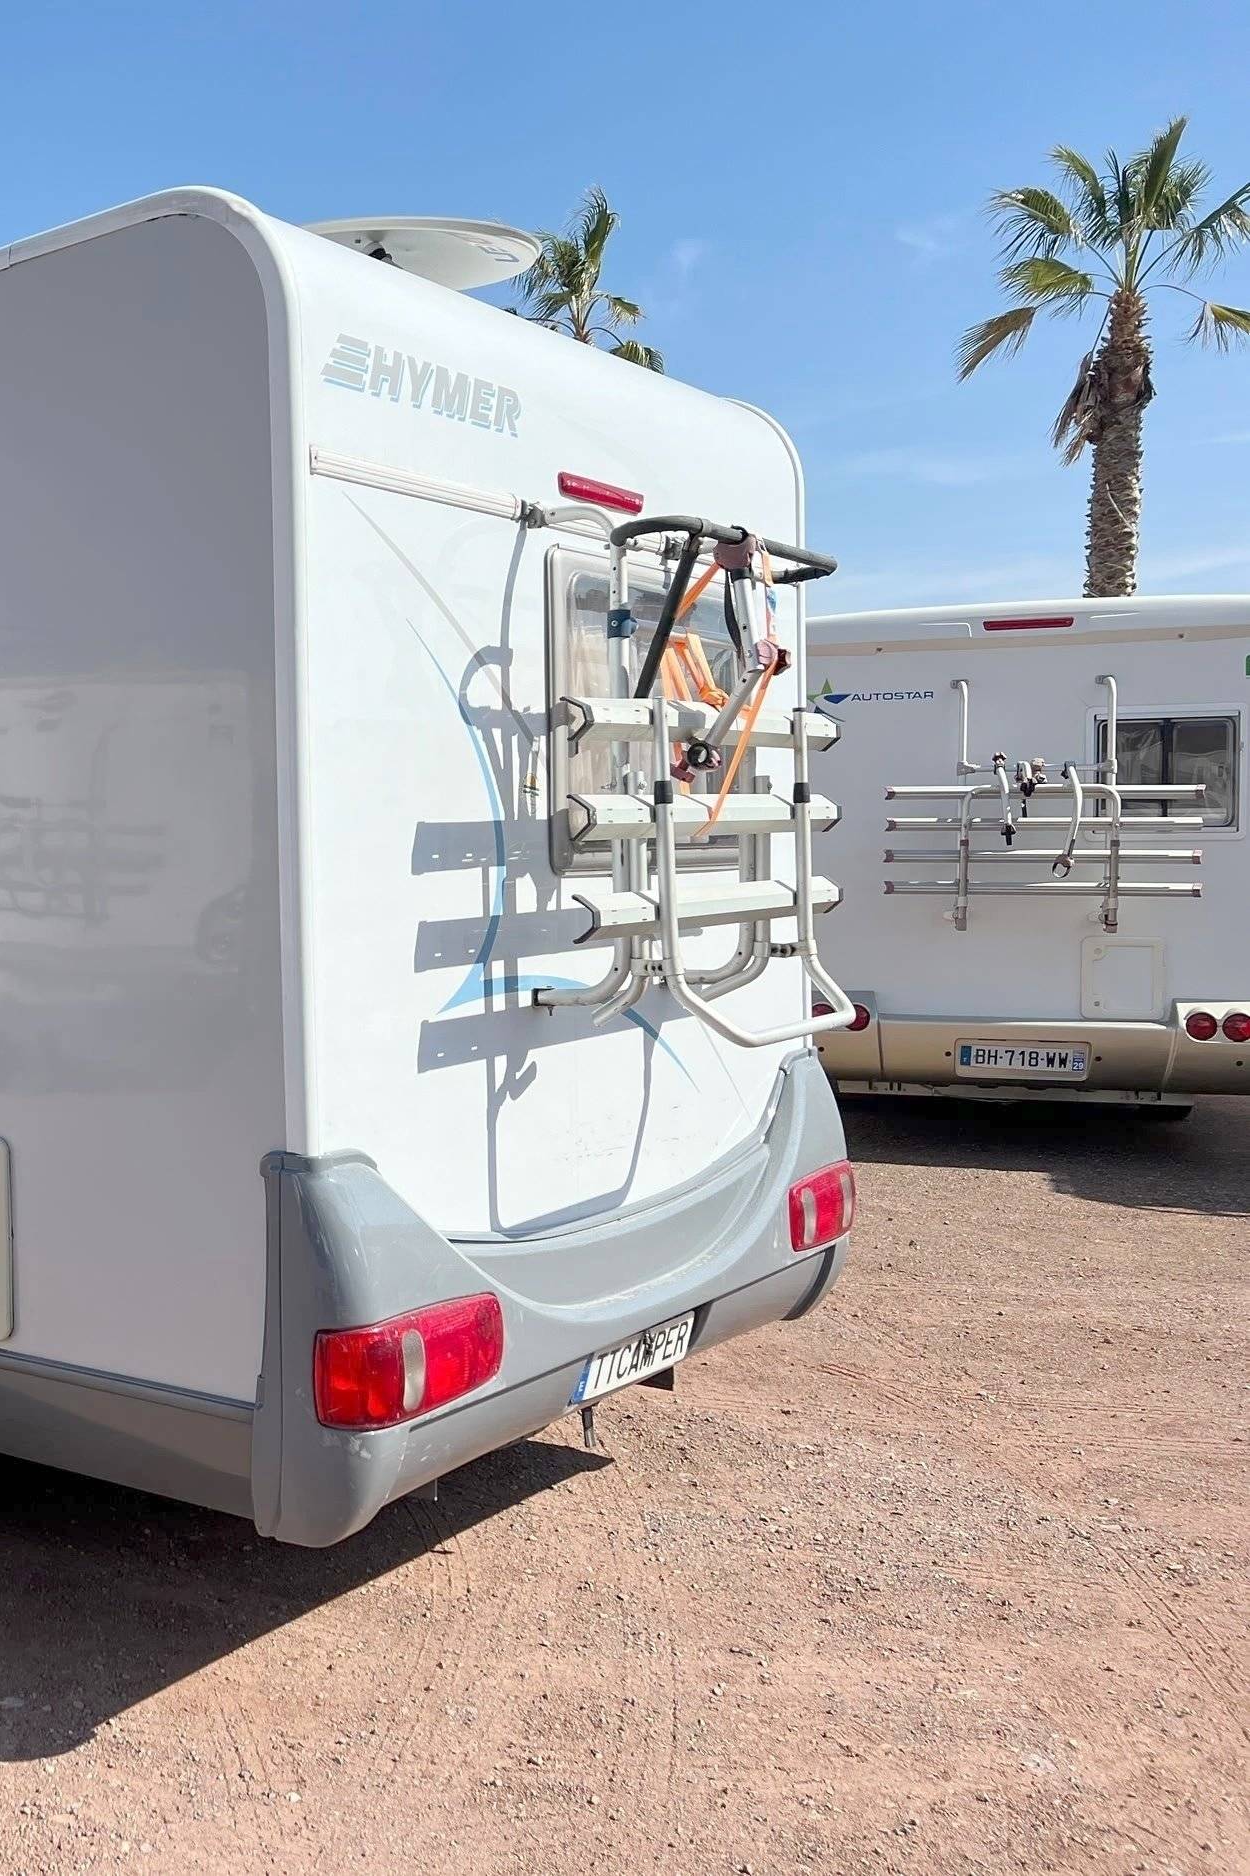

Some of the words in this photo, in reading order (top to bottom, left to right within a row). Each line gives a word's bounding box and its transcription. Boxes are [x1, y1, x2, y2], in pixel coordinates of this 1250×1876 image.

[368, 344, 522, 437] HYMER
[851, 691, 934, 702] AUTOSTAR
[975, 1048, 1069, 1068] BH-718-WW
[1073, 1062, 1084, 1070] 29
[578, 1380, 586, 1392] E
